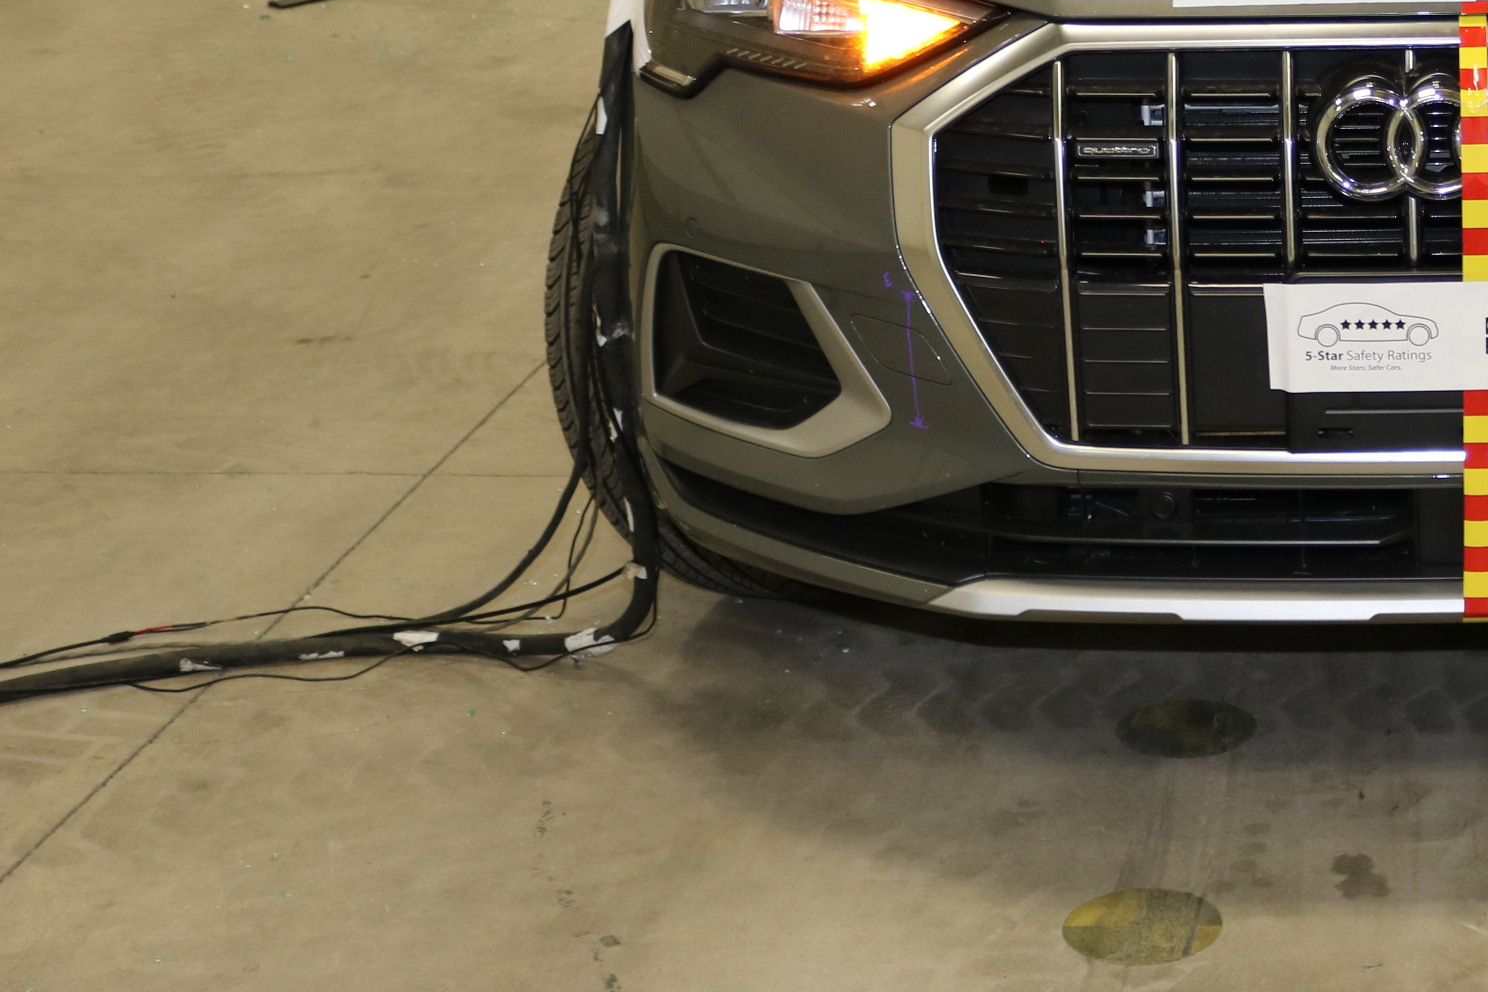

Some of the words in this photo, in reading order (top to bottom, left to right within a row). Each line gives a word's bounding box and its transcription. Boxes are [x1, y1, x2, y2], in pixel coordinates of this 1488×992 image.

[1083, 146, 1151, 156] quattro
[1305, 351, 1344, 361] 5-Star
[1347, 350, 1384, 363] Safety
[1387, 350, 1432, 363] Ratings
